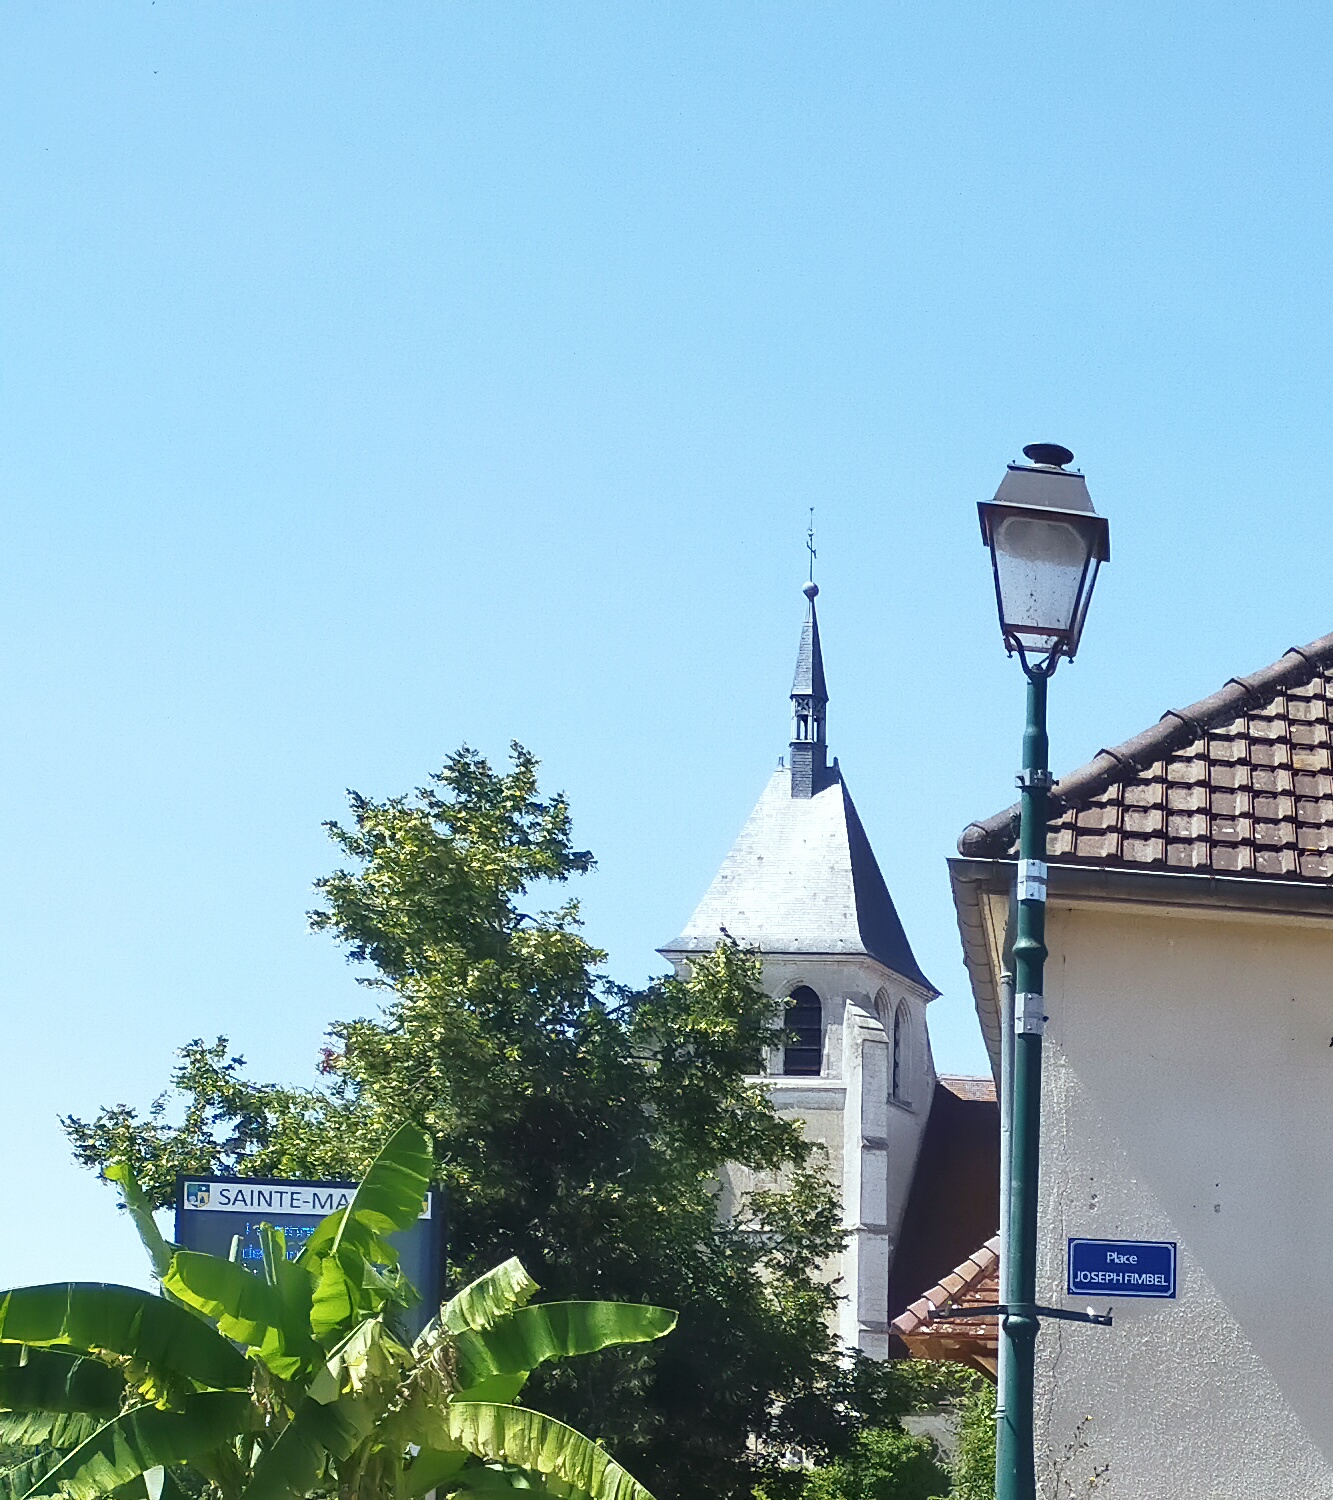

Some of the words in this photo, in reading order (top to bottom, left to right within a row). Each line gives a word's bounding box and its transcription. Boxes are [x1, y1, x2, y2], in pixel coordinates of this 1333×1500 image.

[218, 1187, 351, 1211] SAINTE-MA
[1106, 1251, 1138, 1265] Place
[1074, 1271, 1123, 1284] JOSEPH
[1124, 1273, 1169, 1286] FIMBEL
